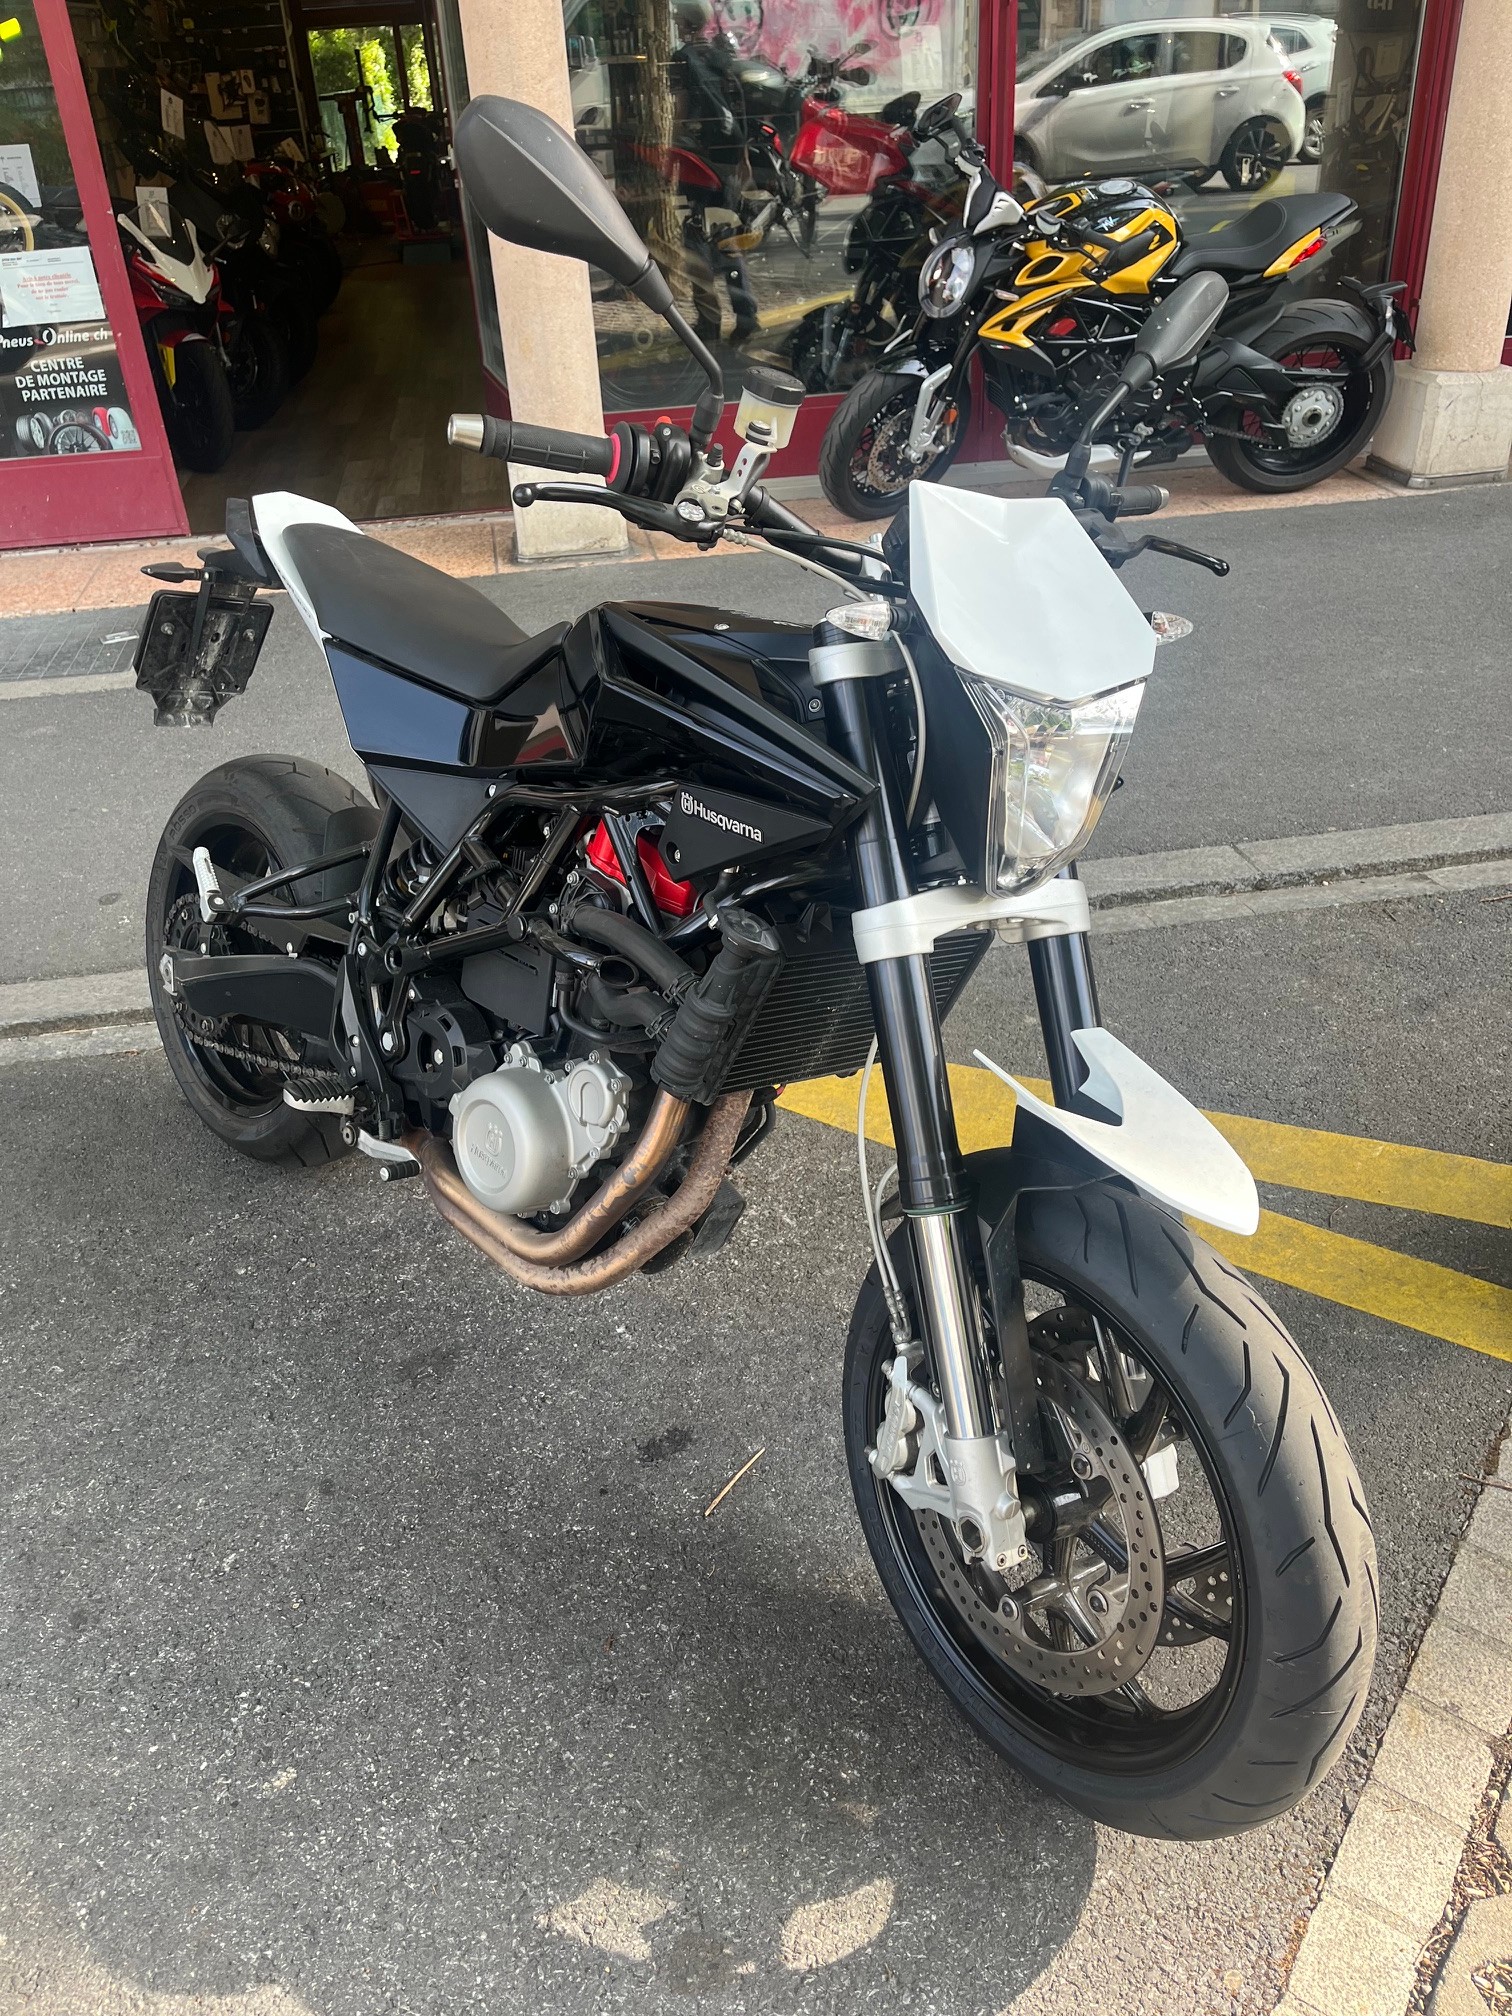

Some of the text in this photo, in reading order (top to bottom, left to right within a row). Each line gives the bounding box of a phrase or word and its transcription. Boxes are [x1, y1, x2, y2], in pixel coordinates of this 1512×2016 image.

[30, 357, 85, 373] CENTRE
[15, 369, 107, 388] DE MONTAGE
[22, 384, 108, 402] PARTENAIRE
[694, 800, 762, 842] Husqvarna
